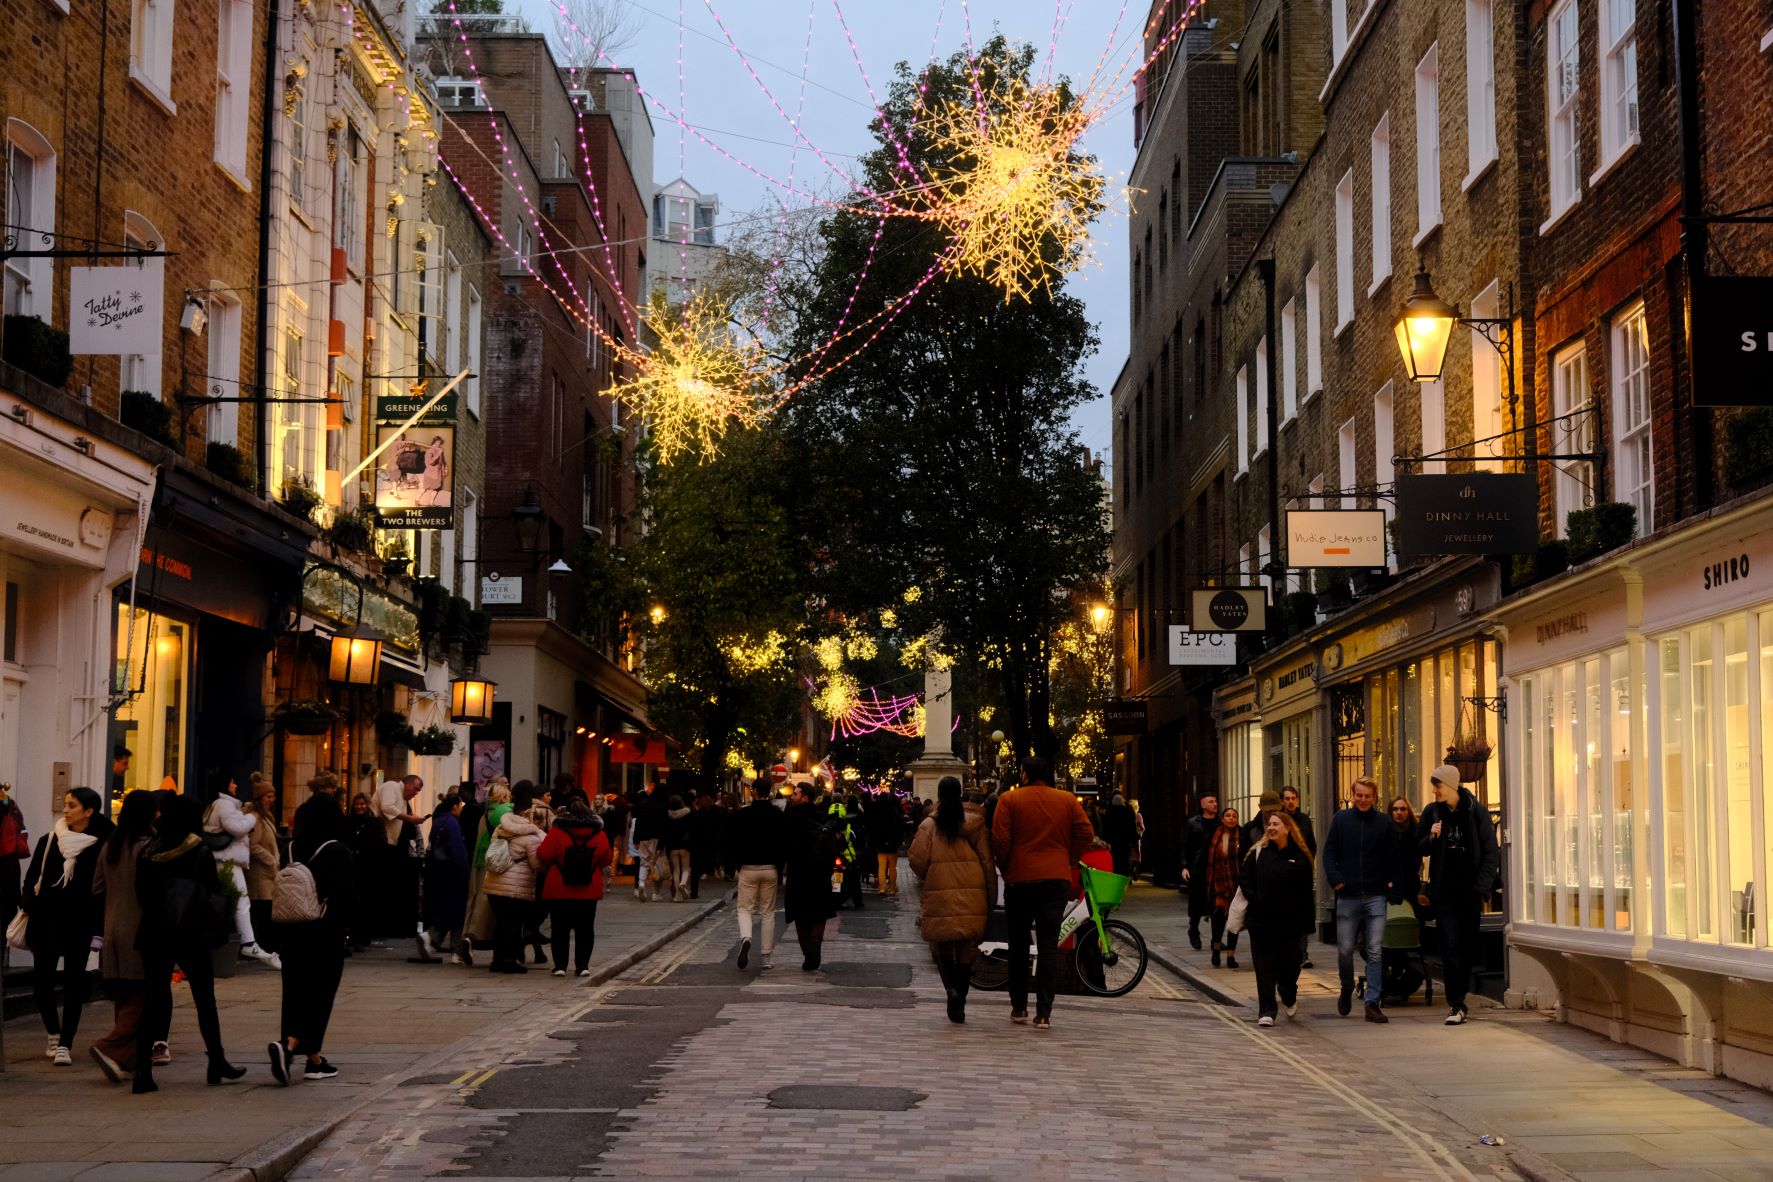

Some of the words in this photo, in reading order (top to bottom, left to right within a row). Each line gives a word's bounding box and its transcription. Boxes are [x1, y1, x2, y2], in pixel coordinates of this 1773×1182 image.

[84, 295, 121, 315] Tatty
[98, 305, 144, 327] Devine
[1741, 330, 1773, 352] S
[385, 404, 421, 412] GREENE
[405, 509, 423, 517] THE
[1426, 511, 1472, 521] DINNY
[1476, 511, 1511, 521] HALL
[382, 517, 404, 526] TWO
[405, 518, 446, 526] BREWERS
[1444, 534, 1494, 543] JEWELLERY
[1704, 553, 1749, 590] SHIRO
[1107, 711, 1145, 719] SASSOON
